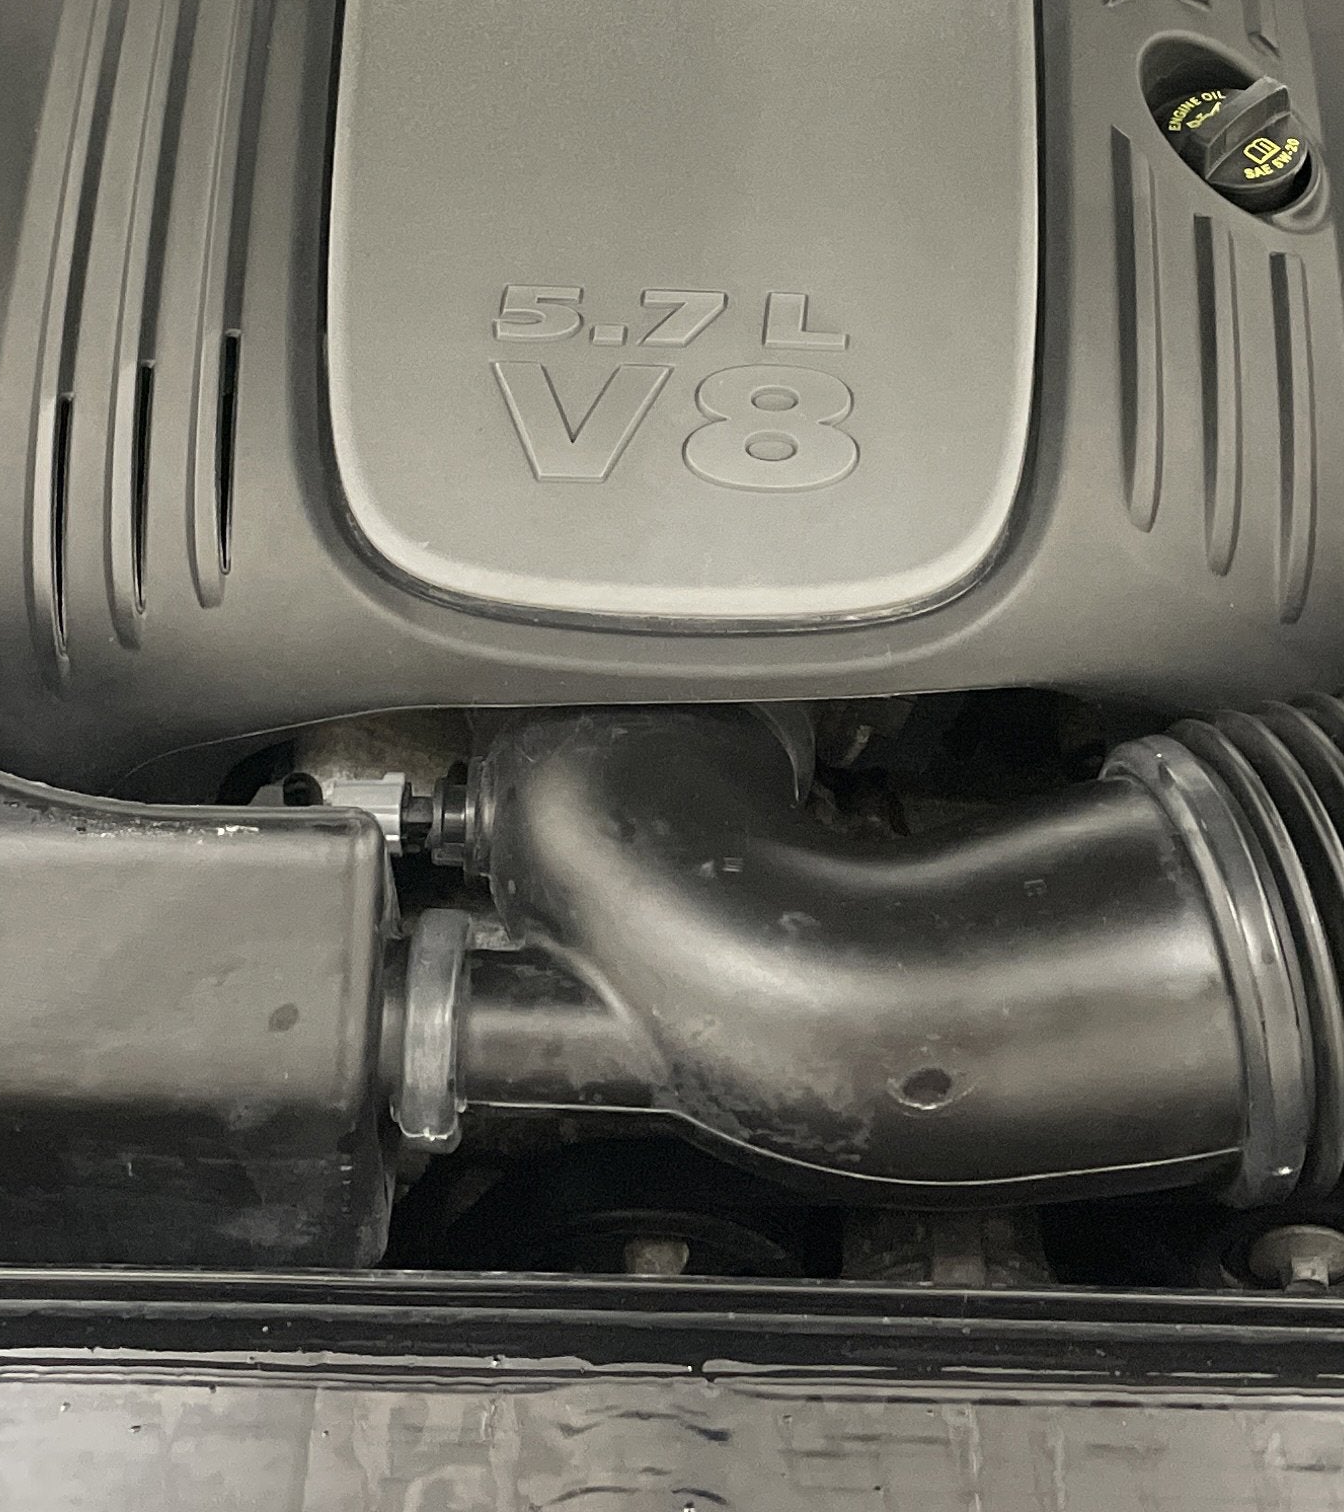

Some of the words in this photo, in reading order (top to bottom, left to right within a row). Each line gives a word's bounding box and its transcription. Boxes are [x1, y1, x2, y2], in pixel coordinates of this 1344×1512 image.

[1168, 96, 1202, 131] ENGINE
[1201, 90, 1226, 102] OIL
[1244, 164, 1274, 179] SAE
[492, 284, 730, 348] 5.7
[762, 291, 851, 350] L
[491, 360, 861, 493] V8
